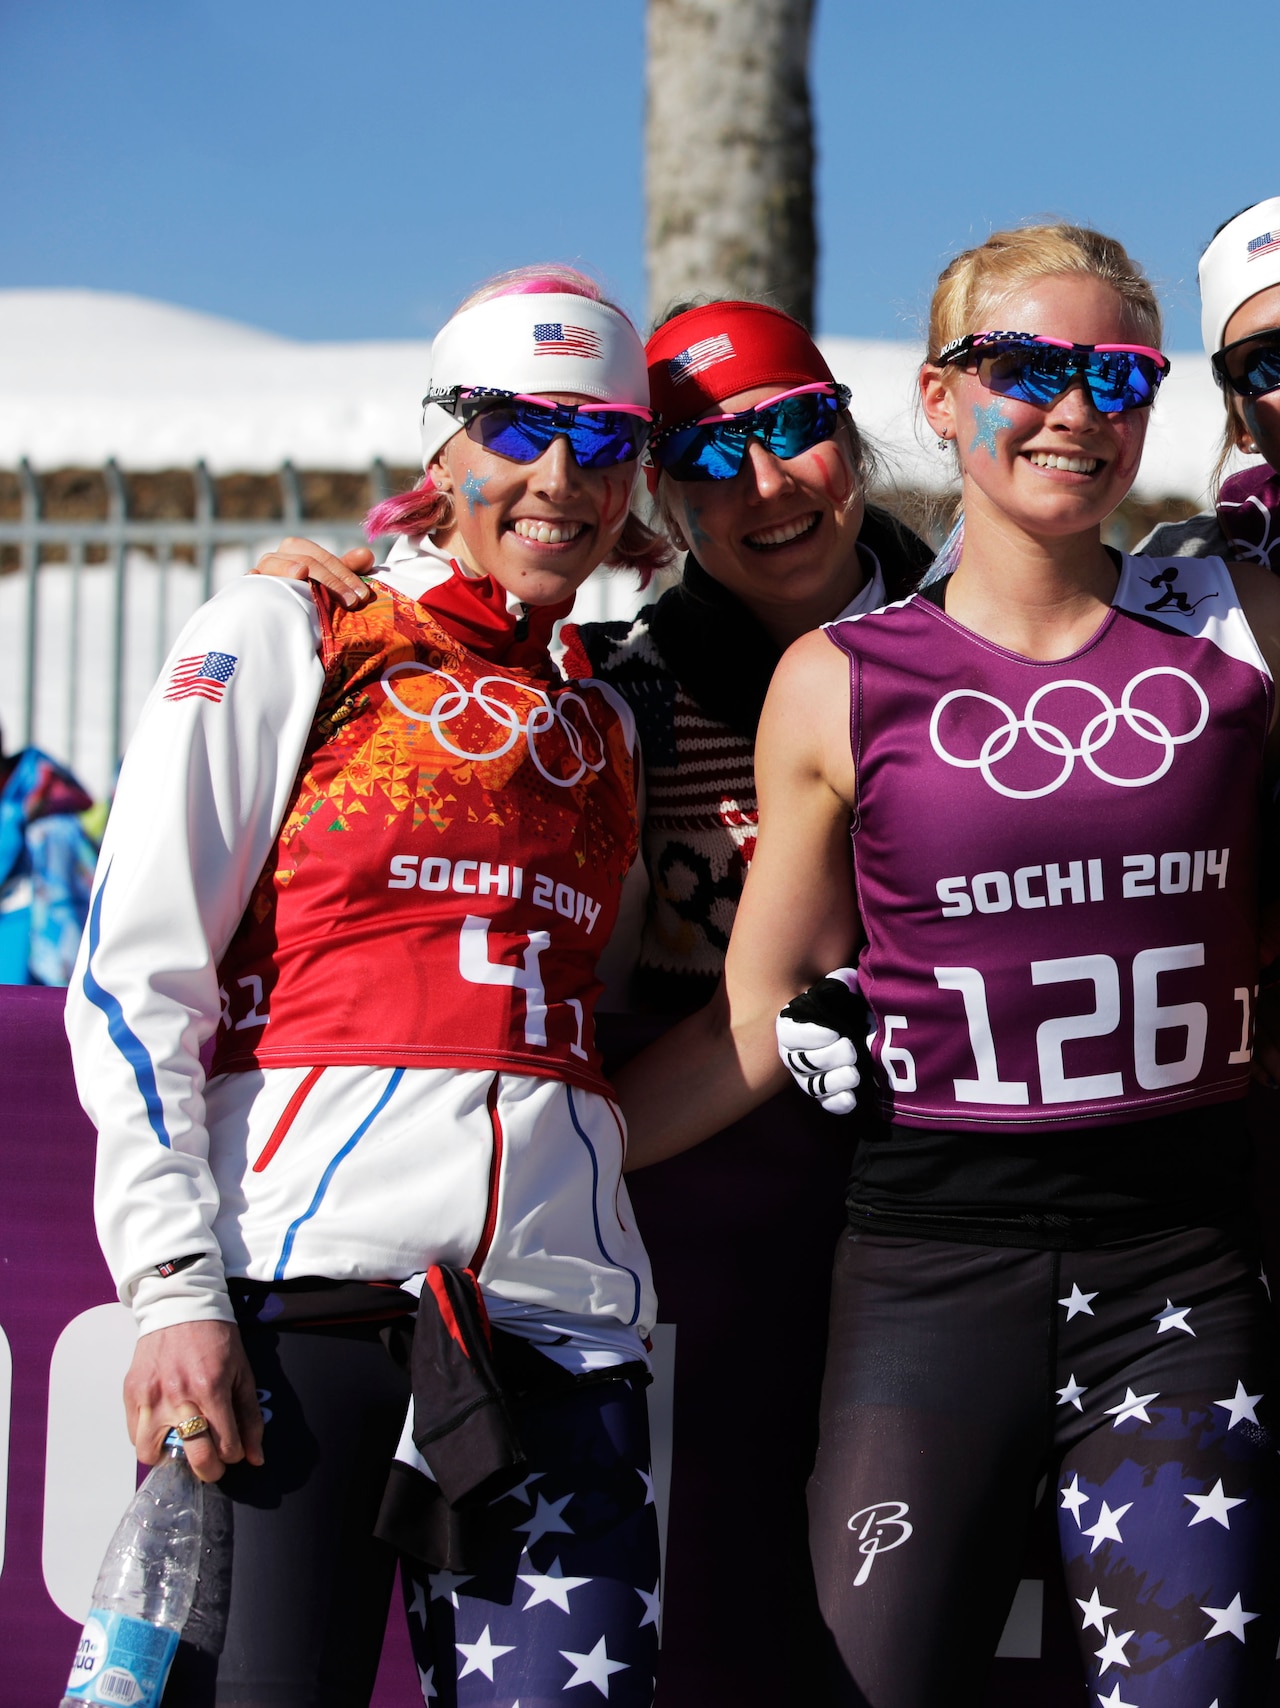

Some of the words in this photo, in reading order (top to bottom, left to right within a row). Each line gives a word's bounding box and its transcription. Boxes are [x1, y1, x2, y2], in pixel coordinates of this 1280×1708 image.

[388, 855, 524, 899] SOCHI
[532, 873, 602, 935] 2014
[935, 858, 1104, 918] SOCHI
[1122, 848, 1230, 899] 2014
[458, 914, 551, 1047] 4
[563, 998, 589, 1062] 1
[933, 942, 1208, 1106] 126
[1227, 984, 1260, 1065] 1
